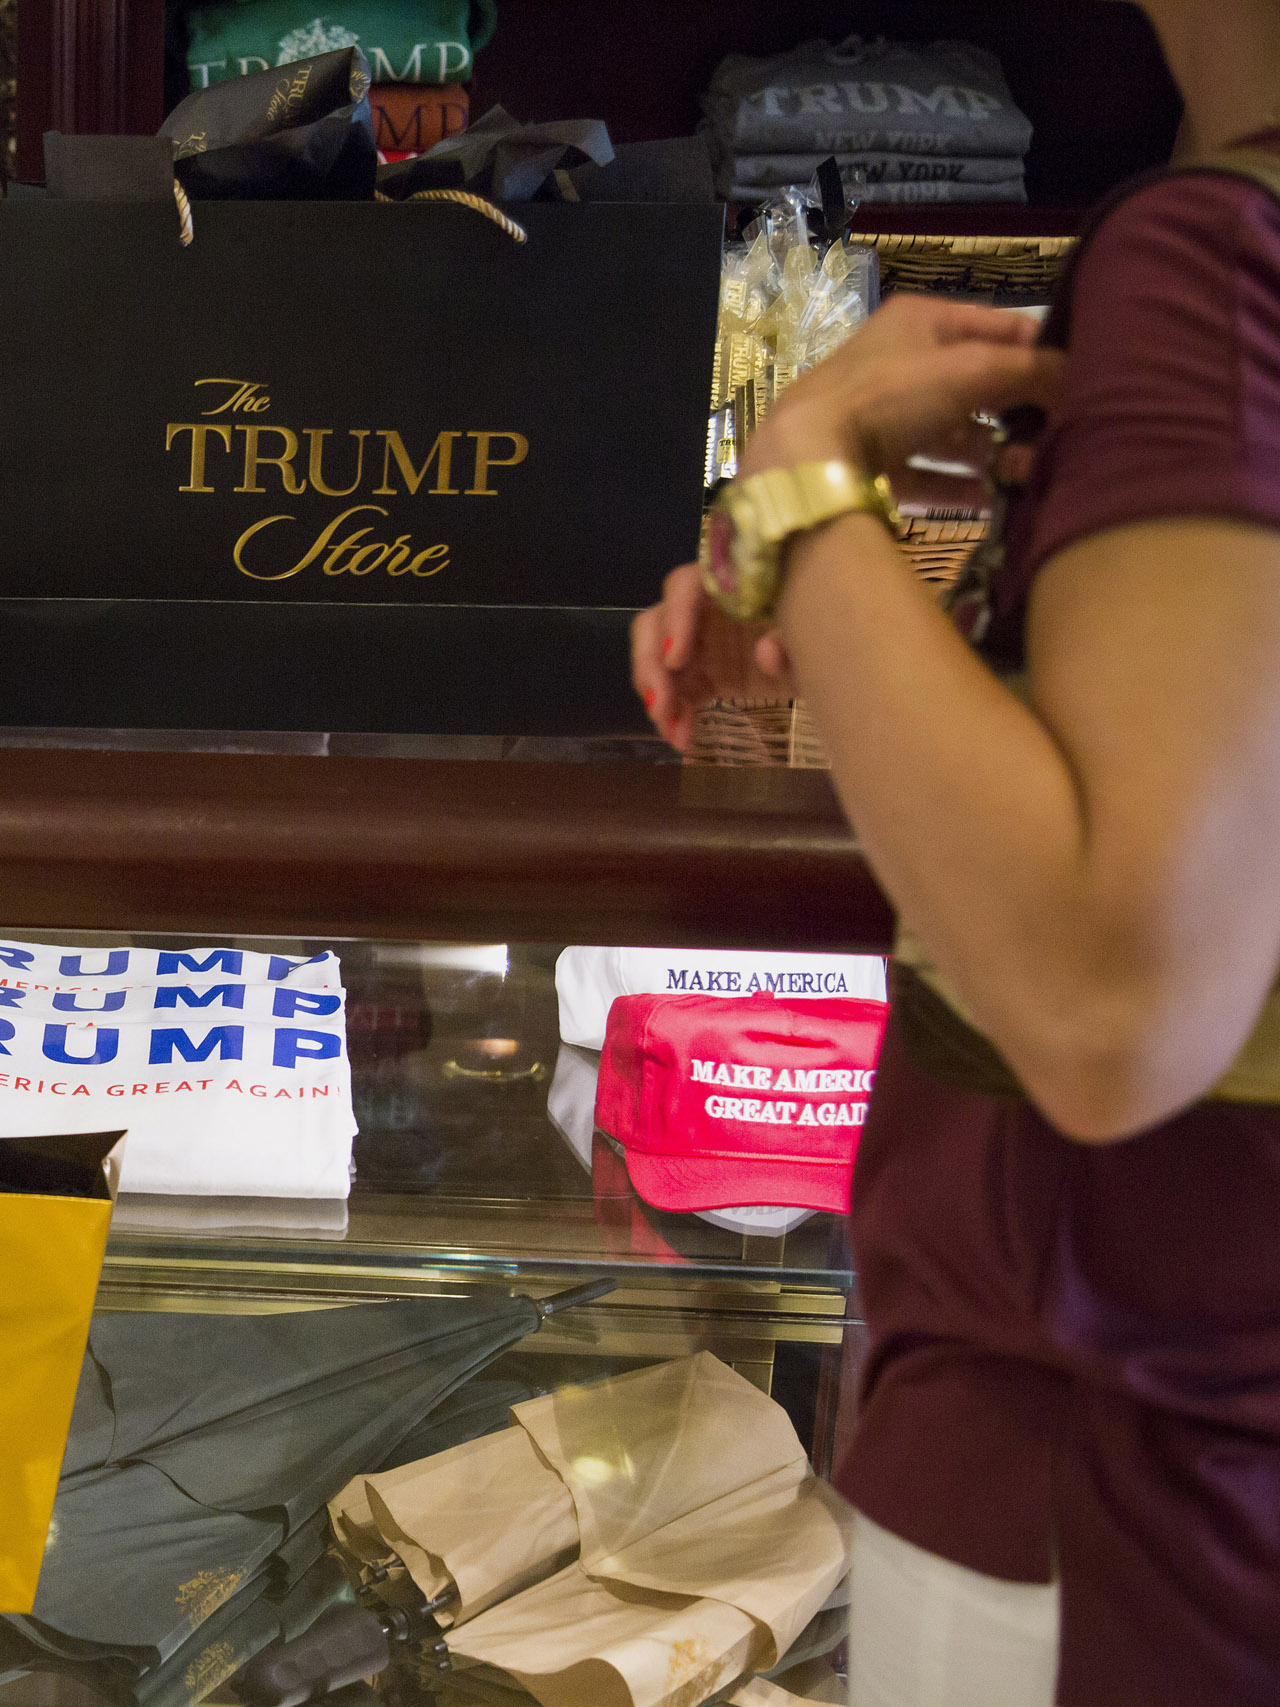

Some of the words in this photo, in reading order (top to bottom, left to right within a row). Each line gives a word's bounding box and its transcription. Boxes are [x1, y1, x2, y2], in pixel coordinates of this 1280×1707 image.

[748, 81, 1003, 120] TRUMP
[891, 161, 964, 183] YORK
[730, 336, 751, 393] TRUM
[194, 378, 271, 416] The
[165, 422, 530, 497] TRUMP
[233, 504, 451, 581] Store
[666, 968, 742, 993] MAKE
[746, 971, 849, 994] AMERICA
[107, 1078, 214, 1097] GREAT
[691, 1058, 772, 1091] MAKE
[772, 1068, 877, 1093] AMERIC
[704, 1095, 797, 1125] GREAT
